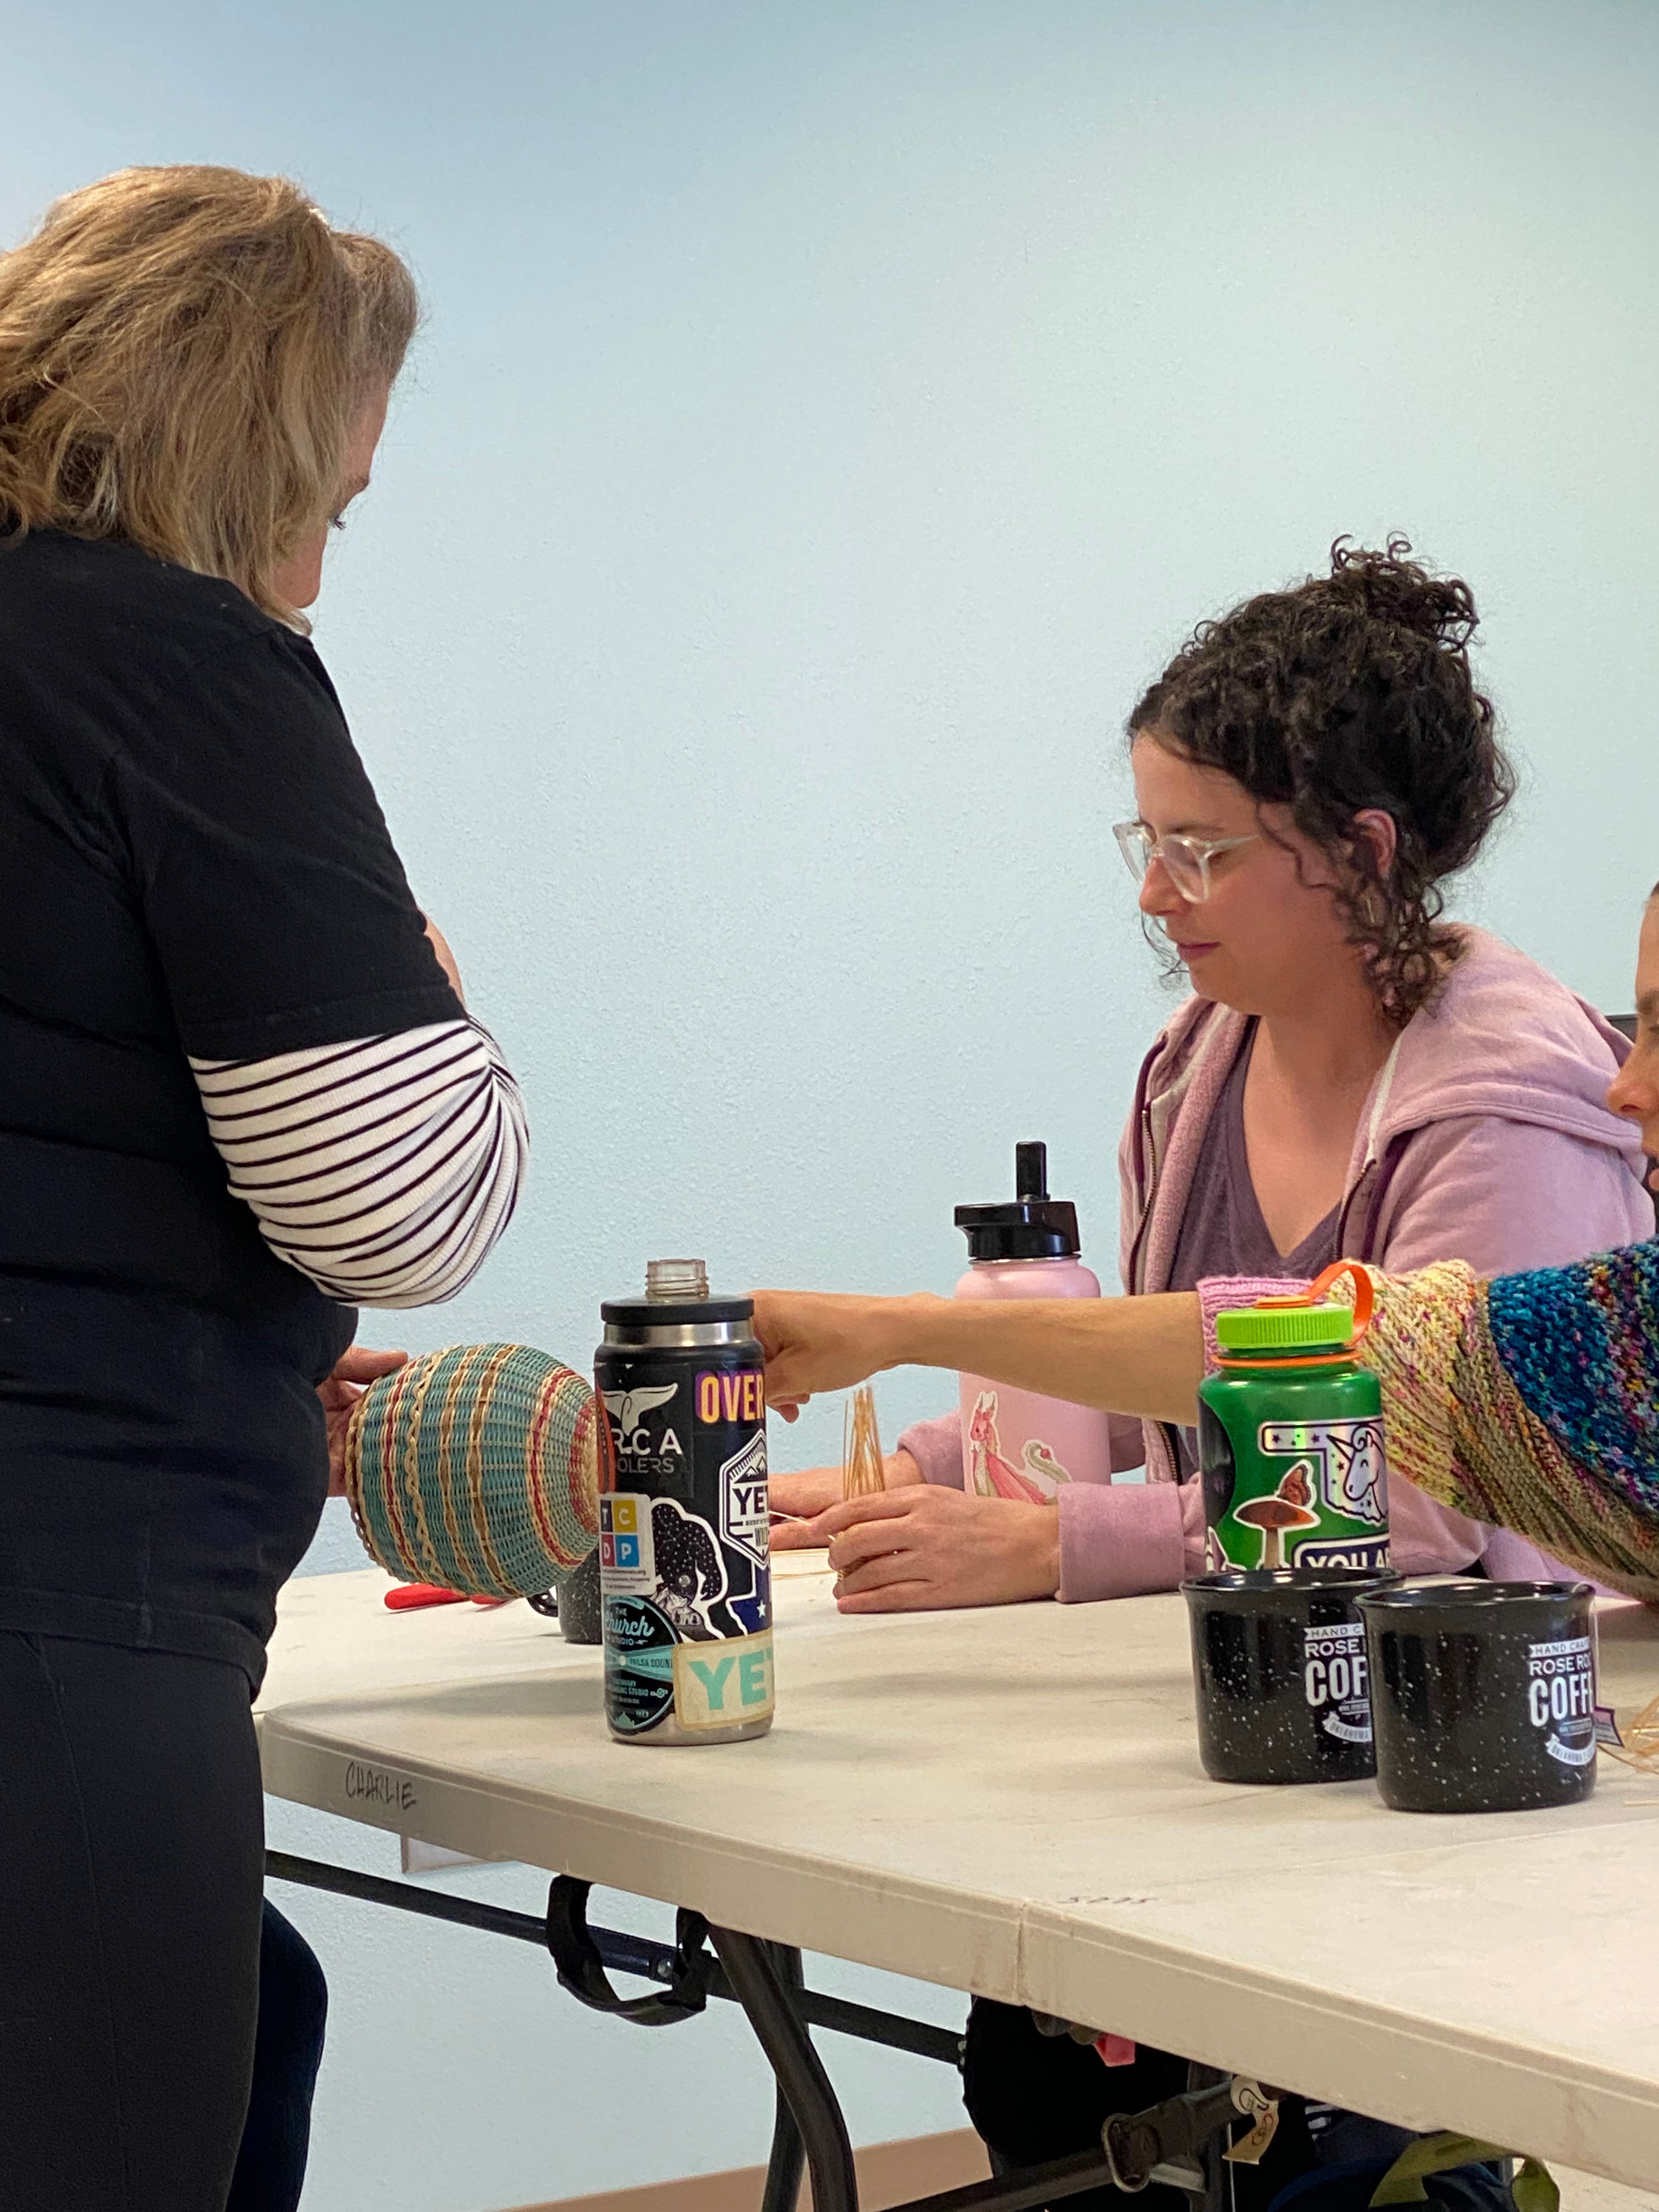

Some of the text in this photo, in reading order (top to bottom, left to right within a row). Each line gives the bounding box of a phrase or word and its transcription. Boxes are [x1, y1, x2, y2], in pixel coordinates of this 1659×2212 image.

[701, 1374, 764, 1423] OVER
[611, 1428, 684, 1455] RCA
[618, 1457, 675, 1474] OLERS
[732, 1485, 768, 1515] YE
[619, 1509, 630, 1525] C
[621, 1543, 631, 1560] P
[1311, 1625, 1361, 1638] HAND C
[1305, 1639, 1361, 1657] ROSE
[1536, 1644, 1566, 1655] HAND
[1530, 1651, 1592, 1676] ROSE RO
[1306, 1655, 1369, 1707] COF
[346, 1762, 417, 1810] CHARLIE
